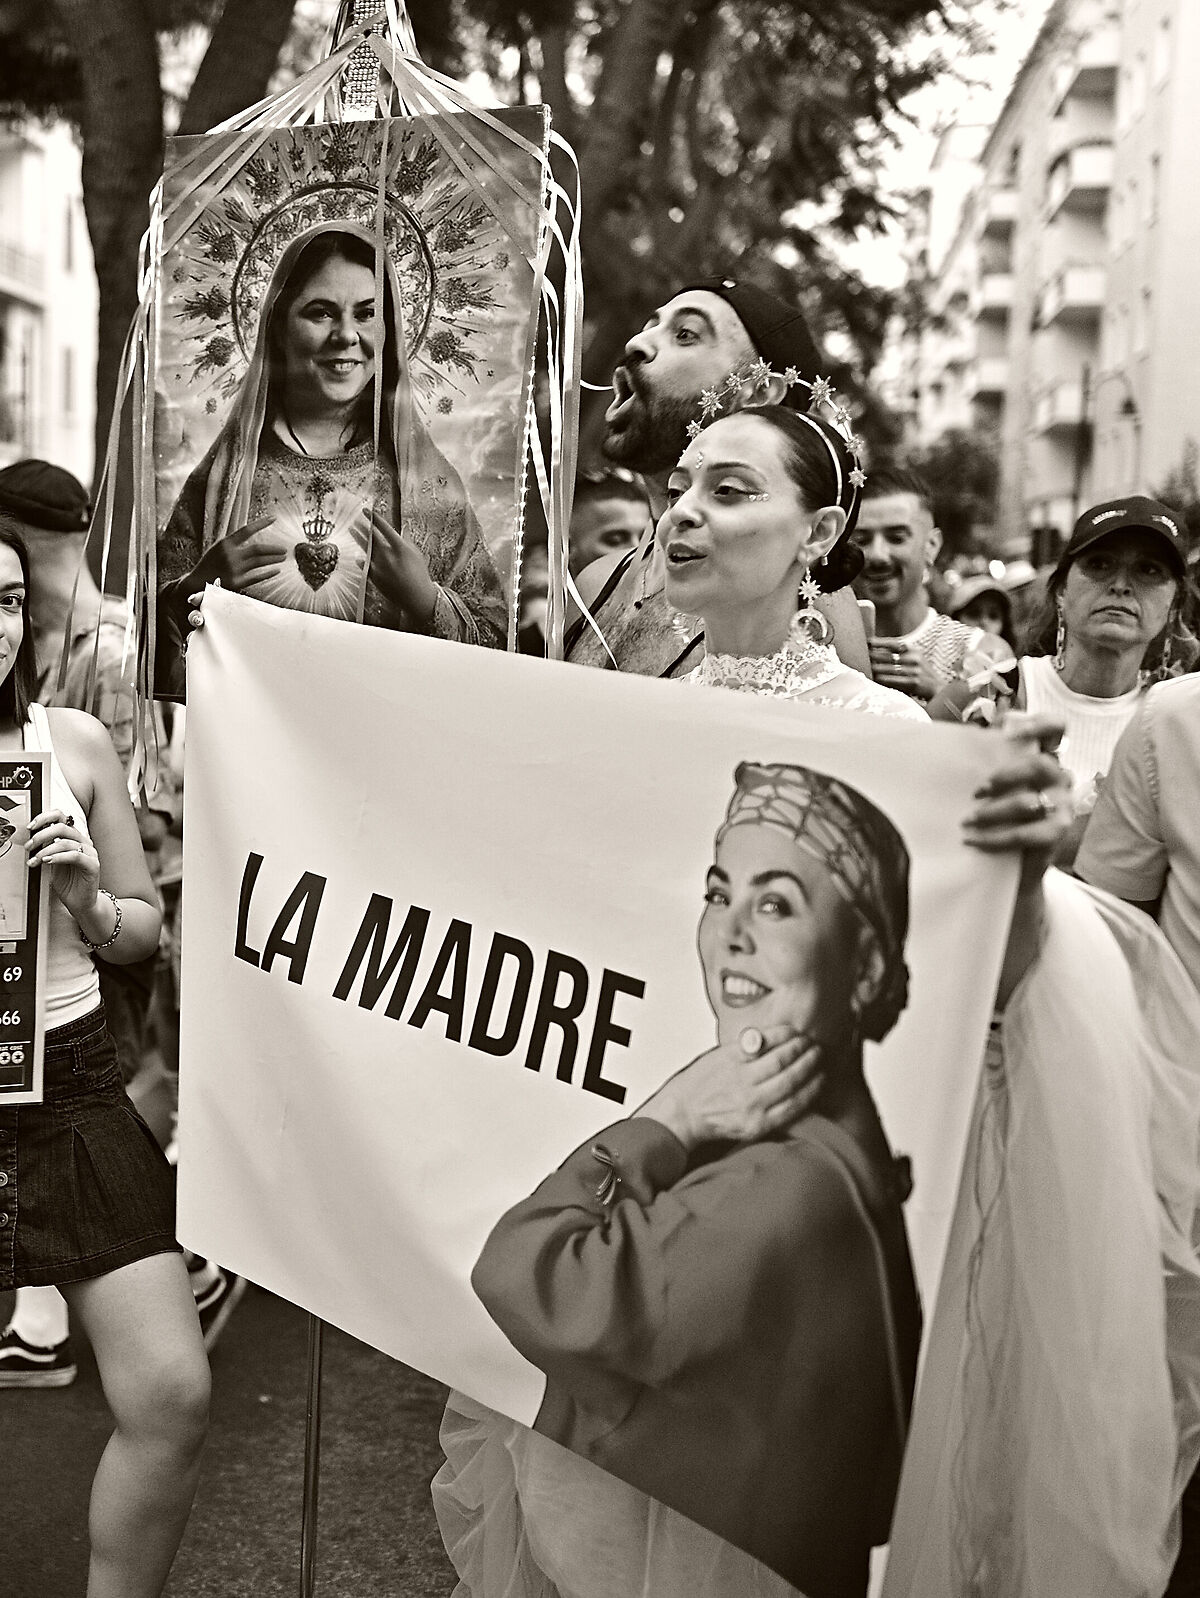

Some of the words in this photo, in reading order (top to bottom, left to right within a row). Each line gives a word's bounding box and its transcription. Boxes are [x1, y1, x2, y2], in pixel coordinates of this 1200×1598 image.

[3, 966, 23, 982] 69
[234, 851, 327, 985] LA
[332, 892, 646, 1105] MADRE
